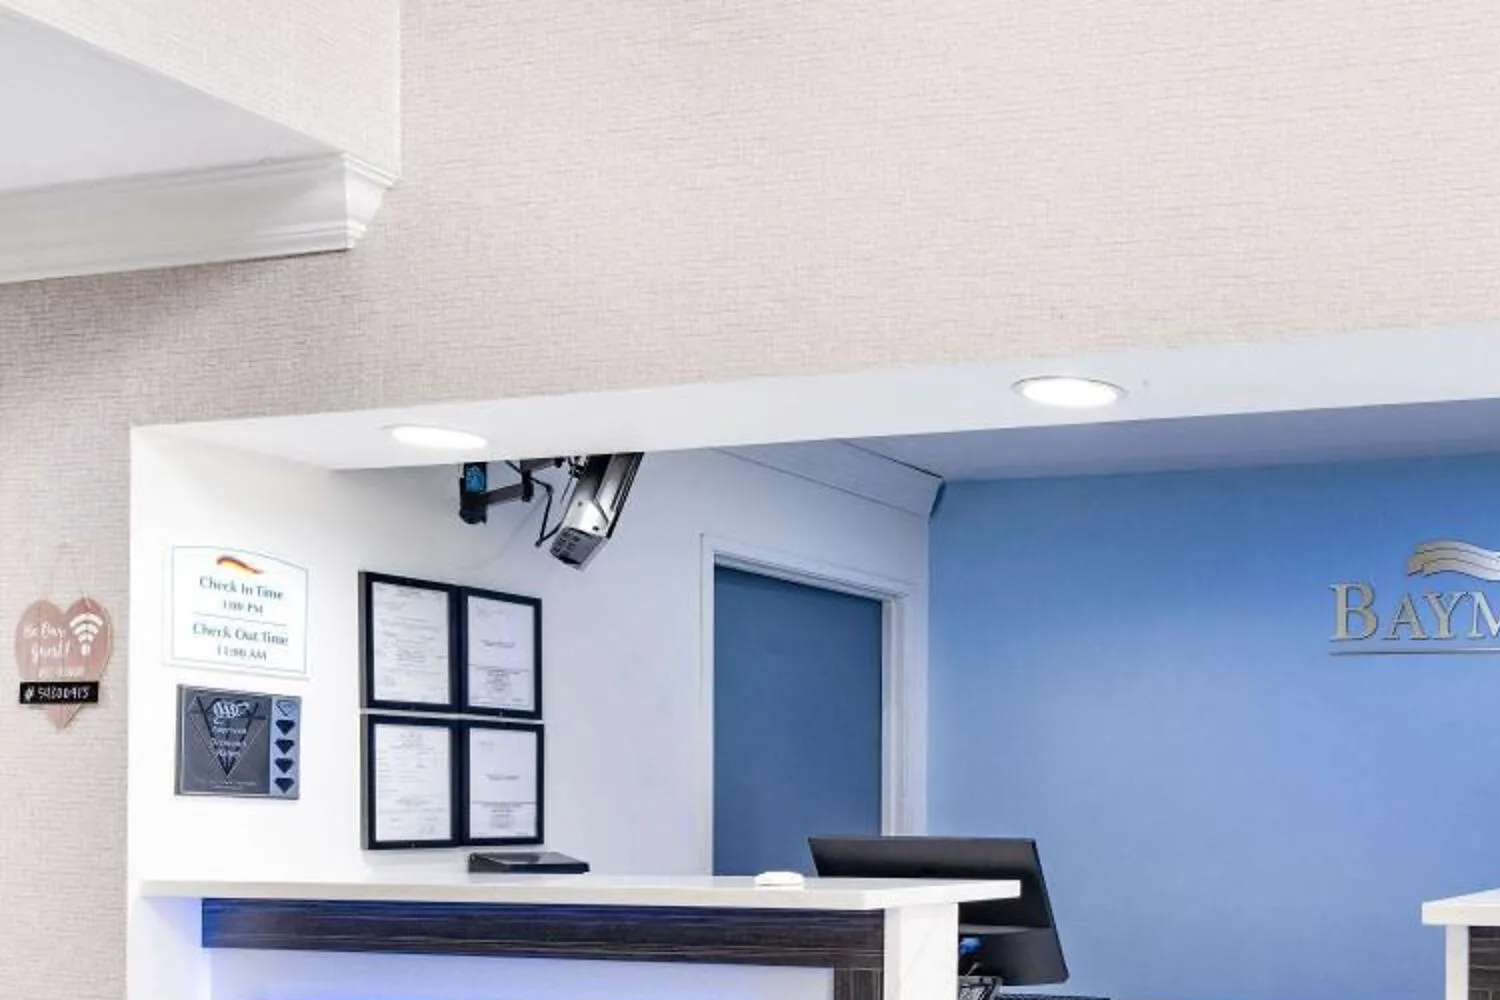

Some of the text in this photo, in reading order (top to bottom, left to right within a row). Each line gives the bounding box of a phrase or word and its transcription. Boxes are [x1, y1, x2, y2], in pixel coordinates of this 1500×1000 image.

[199, 575, 284, 601] Check In Time
[192, 622, 289, 646] Check Out Time
